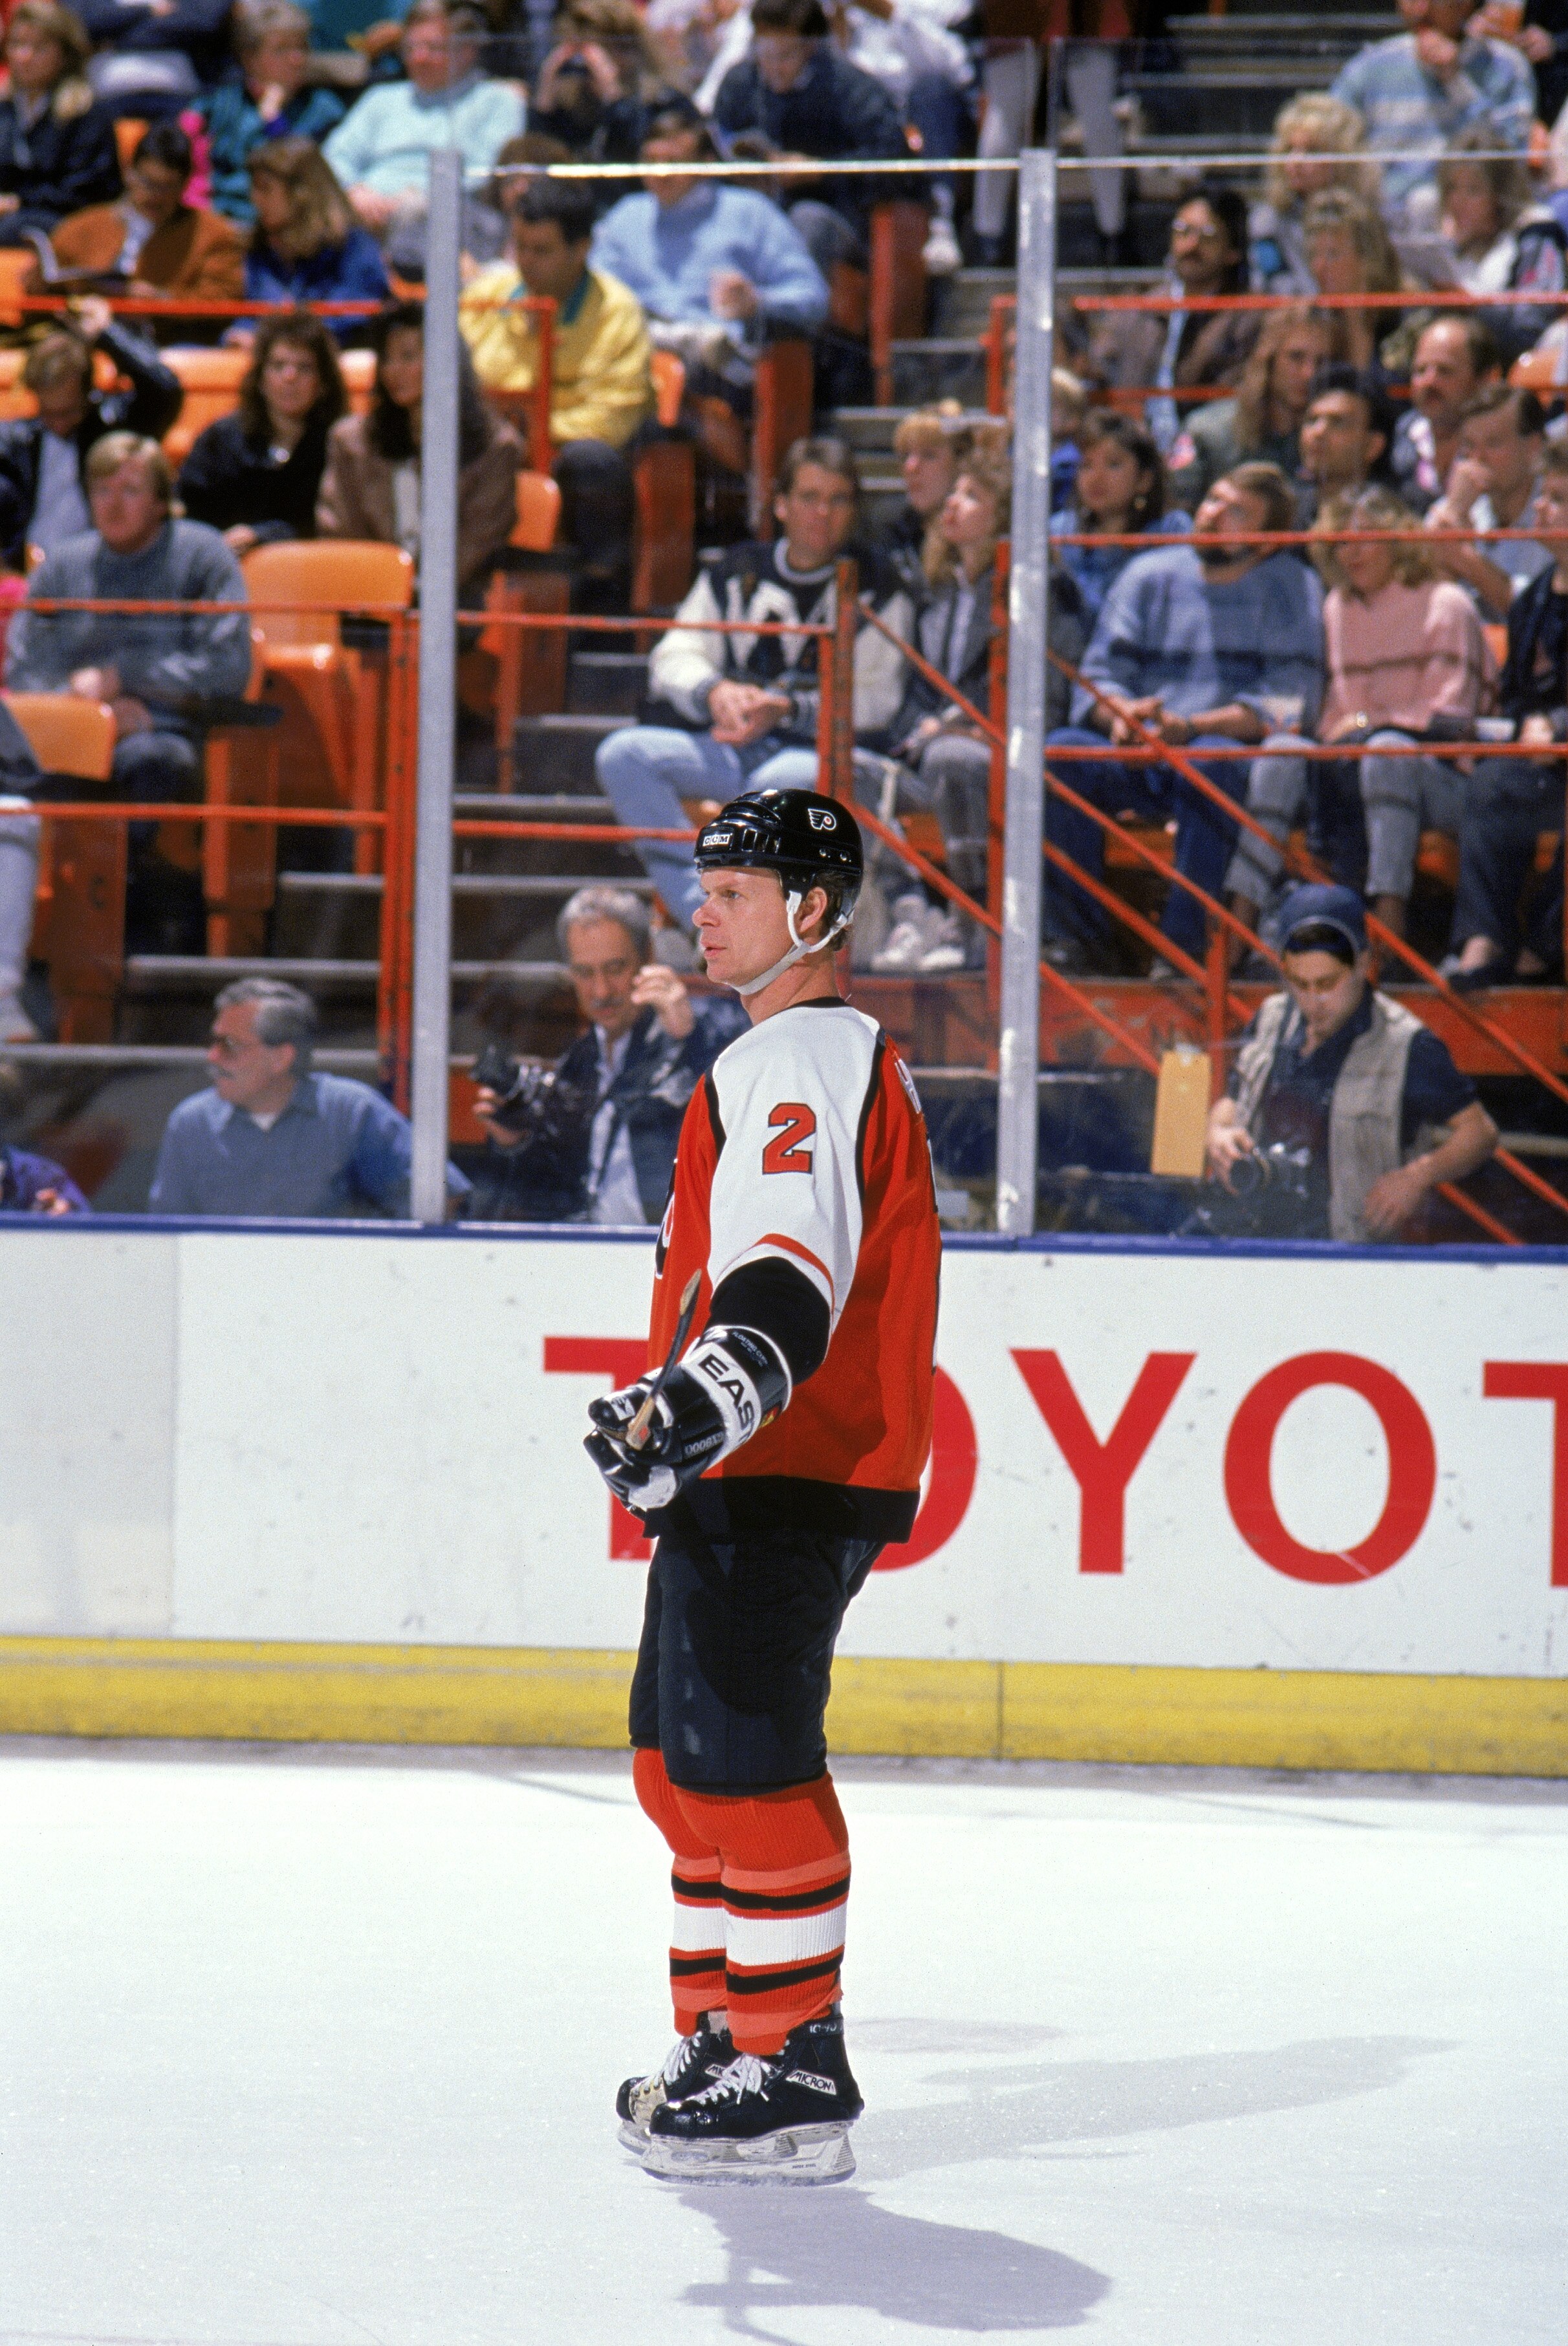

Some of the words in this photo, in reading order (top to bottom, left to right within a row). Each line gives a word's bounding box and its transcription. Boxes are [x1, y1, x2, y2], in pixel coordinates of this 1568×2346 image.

[704, 834, 730, 845] CCM
[762, 1102, 816, 1175] 2
[789, 2071, 833, 2091] MICRON
